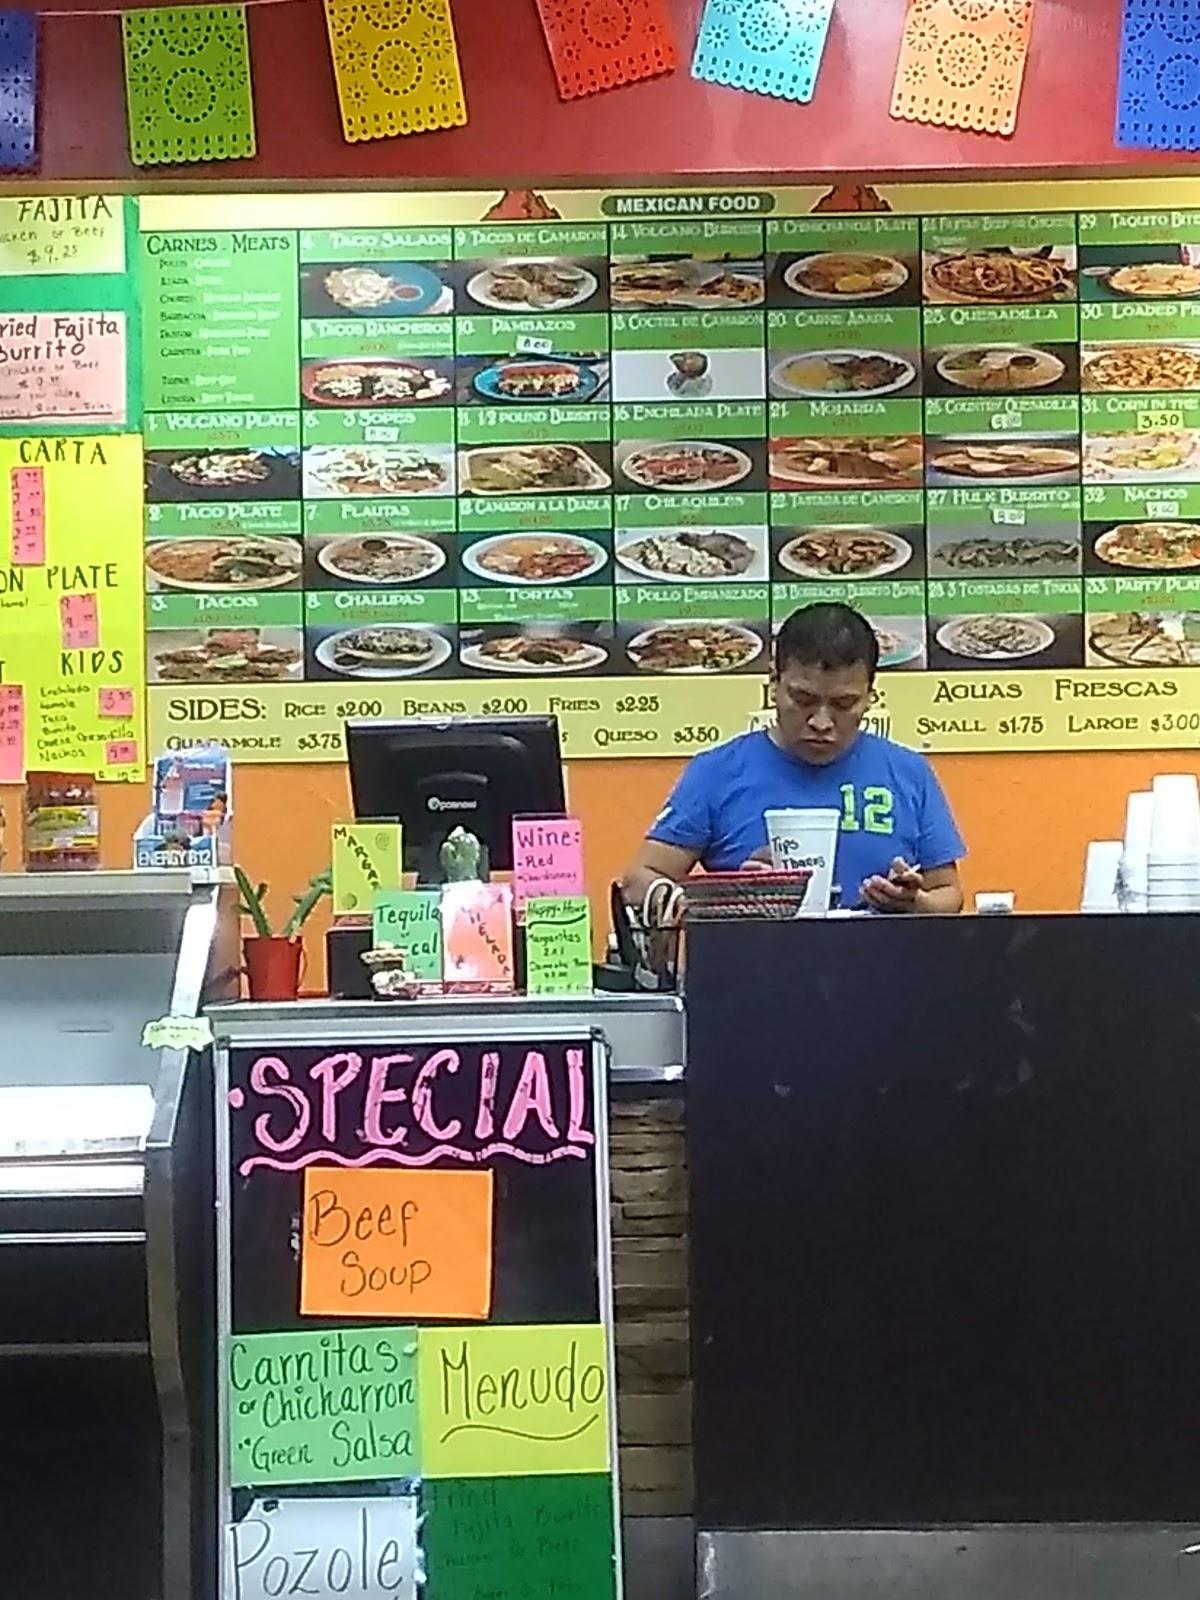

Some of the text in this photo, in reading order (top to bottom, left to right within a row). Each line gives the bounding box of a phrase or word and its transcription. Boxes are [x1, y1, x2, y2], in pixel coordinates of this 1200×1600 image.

[18, 195, 112, 222] FAJITA
[617, 195, 760, 213] MEXICAN FOOD
[1110, 213, 1168, 228] TAQUITO
[381, 230, 451, 248] SALADS
[472, 229, 515, 245] TACOS
[518, 231, 535, 243] DE
[631, 222, 701, 238] VOLCANO
[146, 234, 290, 255] CARNES MEATS
[950, 307, 1059, 325] QUESADILLA
[1111, 303, 1178, 319] LOADED
[53, 312, 120, 343] Fajita
[319, 320, 365, 336] TACOS
[491, 318, 576, 335] PAMBAZOS
[632, 404, 714, 421] ENCHILADA
[717, 404, 762, 419] PLATE
[810, 401, 886, 418] MOJARRA
[1106, 397, 1149, 413] CORN
[166, 411, 298, 429] VOLCANO PLATE
[358, 411, 416, 427] SOPES
[1141, 413, 1180, 429] 3.50
[19, 438, 107, 465] CARTA
[953, 489, 996, 504] HULK
[1000, 486, 1070, 504] BURRITO
[1123, 487, 1188, 503] NACHOS
[177, 504, 224, 520] TACO
[227, 504, 282, 520] PLATE
[341, 503, 410, 520] FLAUTAS
[46, 562, 118, 590] PLATE
[637, 586, 768, 603] POLLO EMPANIZADO
[1115, 579, 1162, 594] PARTY
[195, 594, 258, 610] TACOS
[502, 588, 574, 604] TORTAS
[61, 649, 124, 677] KIDS
[1055, 678, 1179, 702] FRESCAS
[167, 698, 267, 721] SIDES:
[284, 702, 326, 719] RICE
[403, 699, 466, 716] BEANS
[548, 696, 601, 712] FRIES
[615, 696, 660, 712] $2.25
[916, 716, 987, 735] SMALL
[998, 715, 1045, 734] $1.75
[1067, 714, 1139, 733] LARGE
[297, 733, 342, 750] $3.75
[594, 728, 659, 747] QUESO
[839, 783, 894, 835] 12
[516, 827, 581, 848] Wine:
[772, 836, 799, 855] Tips
[376, 901, 440, 931] Tequila
[250, 1048, 596, 1153] SPECIAL
[308, 1188, 420, 1248] Beef
[340, 1250, 432, 1298] Soup
[229, 1332, 400, 1392] Carnitas
[440, 1341, 605, 1420] Menudo
[238, 1377, 416, 1428] or Chicharron
[250, 1419, 412, 1473] Green Salsa
[229, 1507, 403, 1600] Pozole
